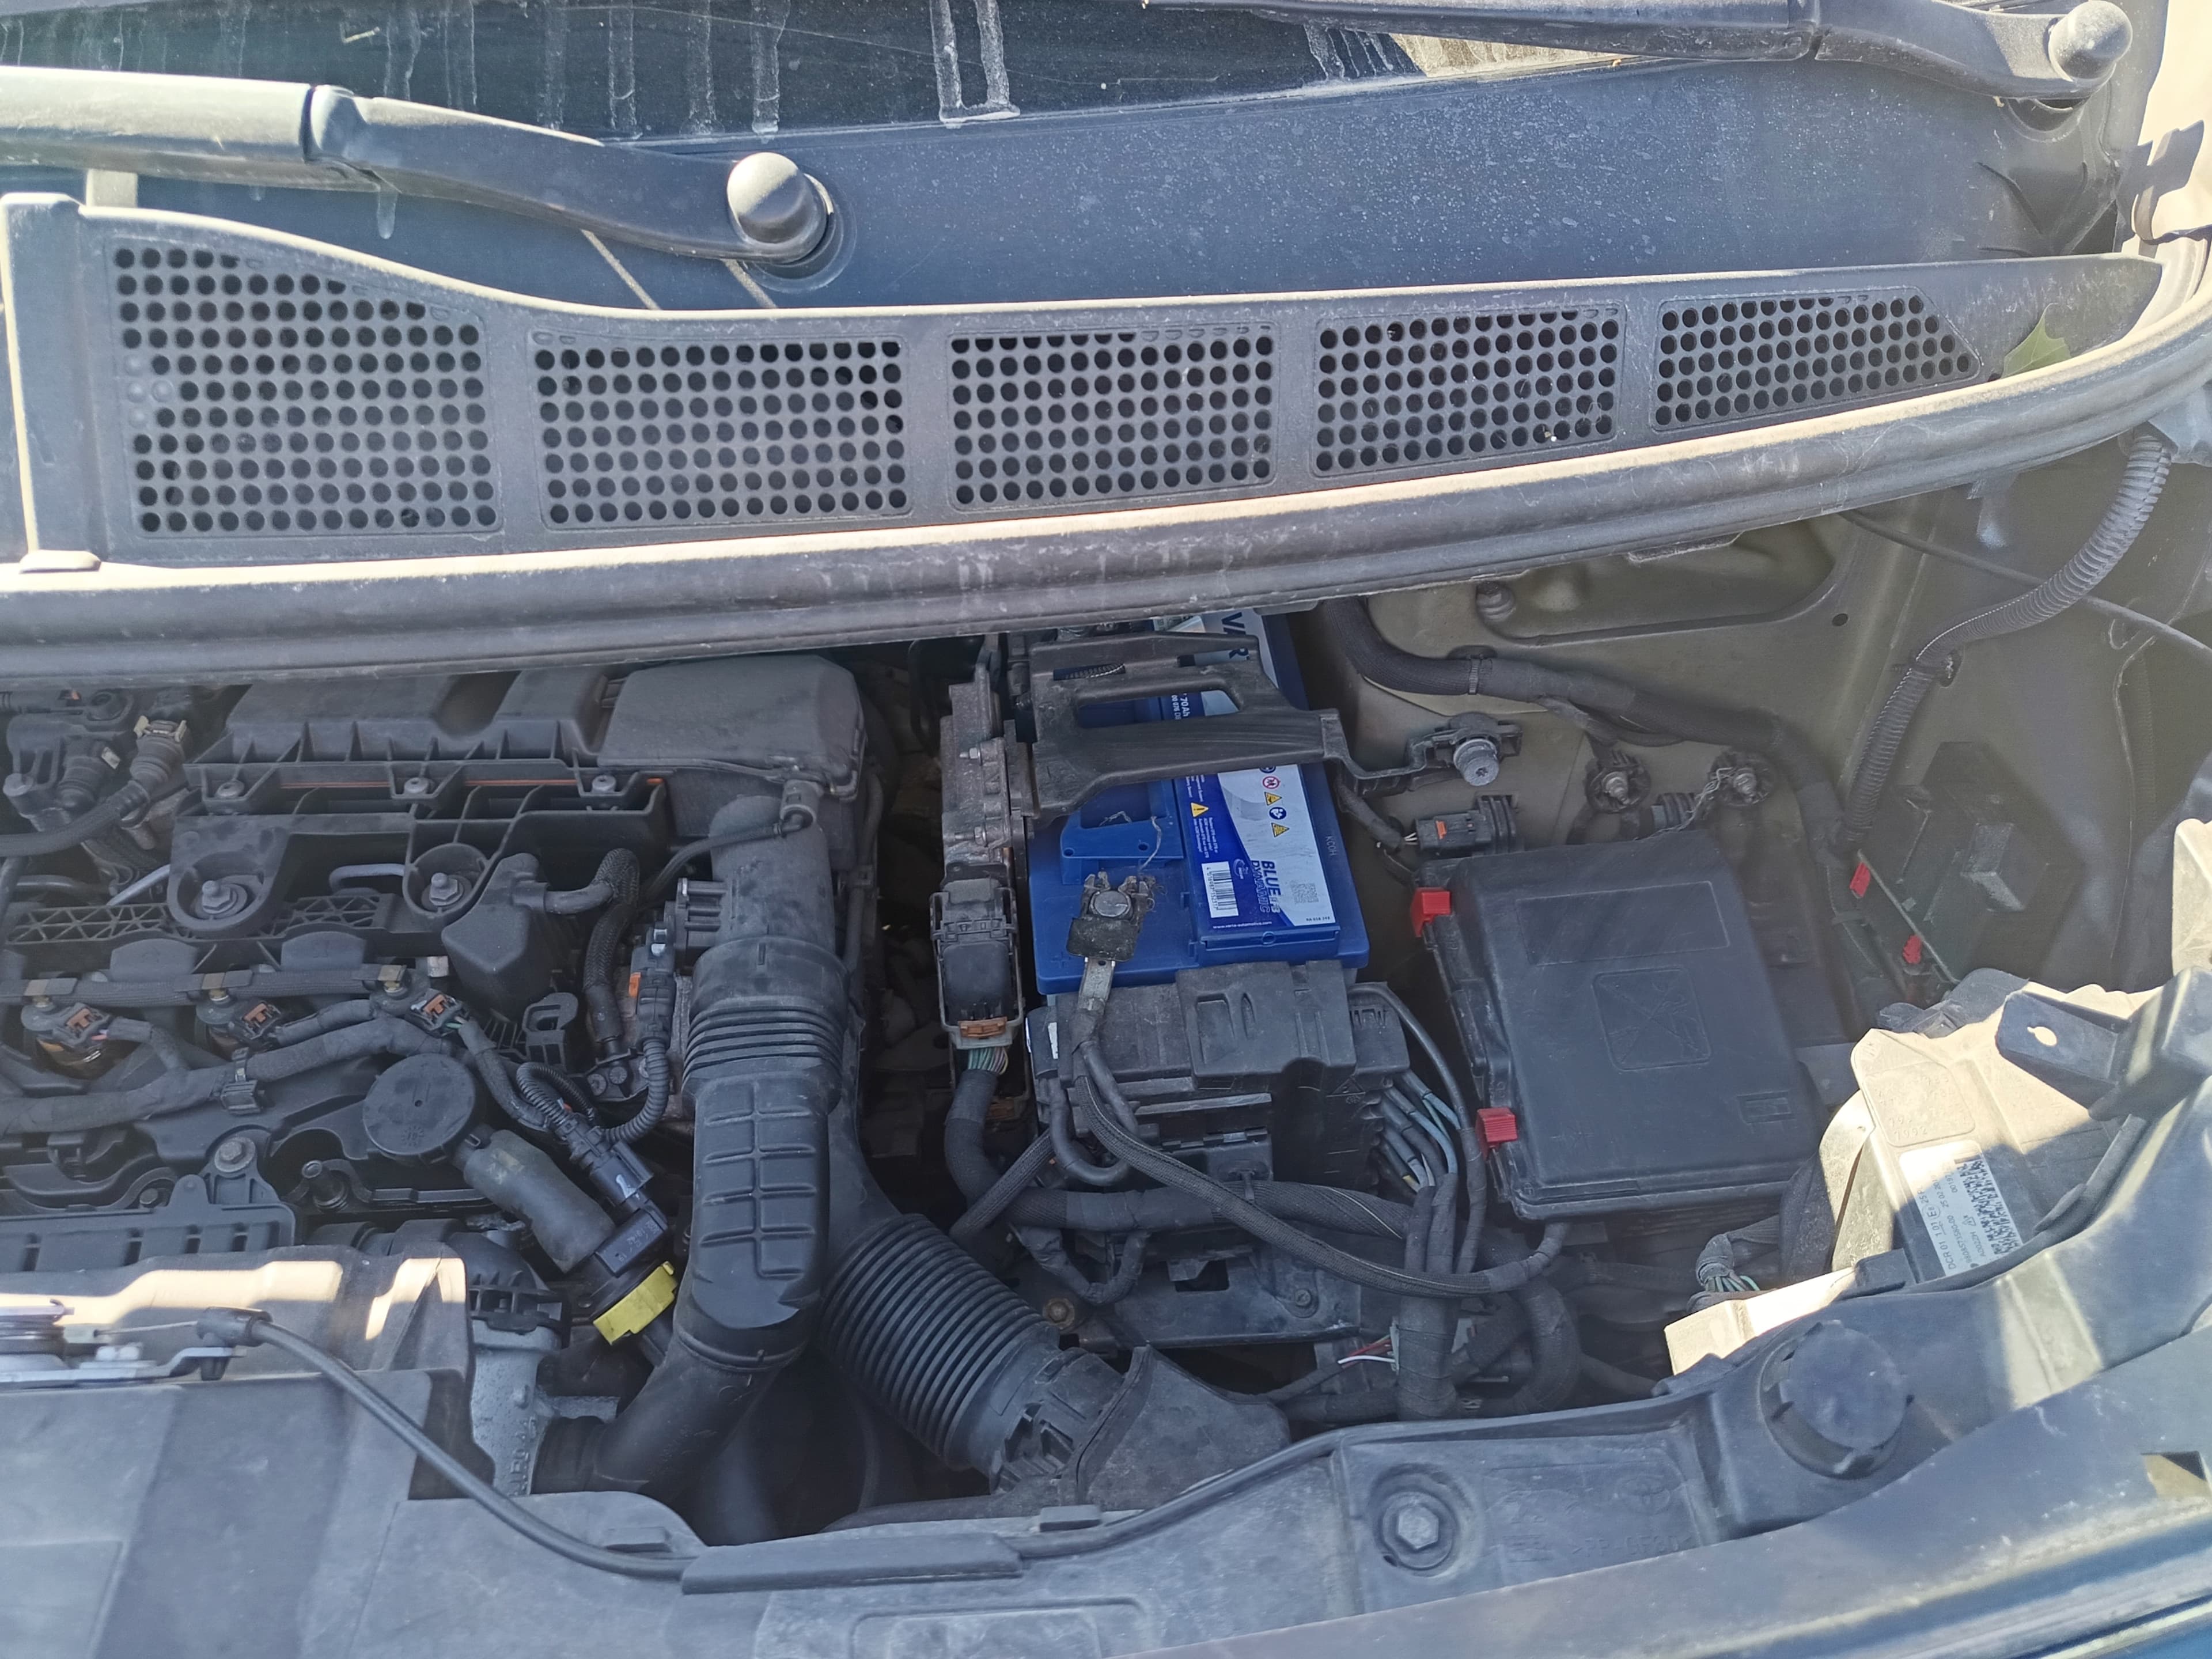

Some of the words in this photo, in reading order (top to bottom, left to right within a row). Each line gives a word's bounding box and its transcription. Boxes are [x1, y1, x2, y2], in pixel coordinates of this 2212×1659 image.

[1251, 860, 1271, 913] DYNAMIC
[1261, 861, 1281, 896] BLUE
[1919, 1195, 1929, 1203] 25
